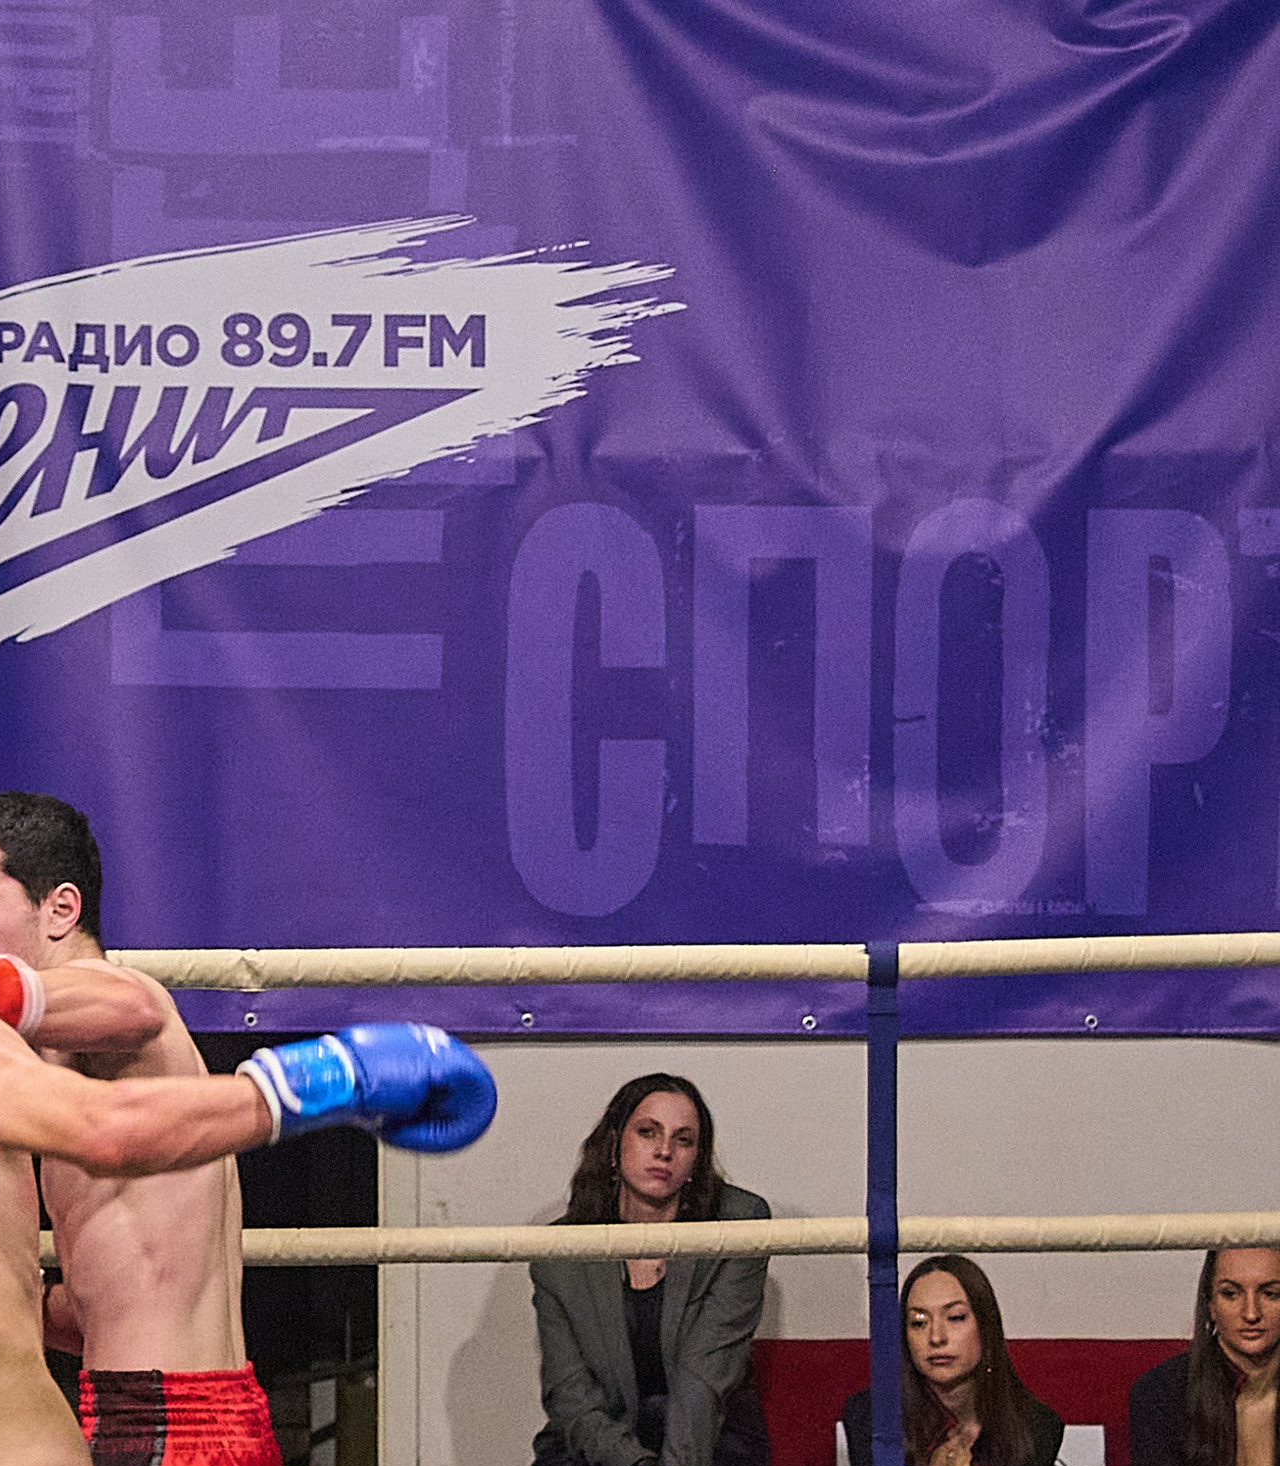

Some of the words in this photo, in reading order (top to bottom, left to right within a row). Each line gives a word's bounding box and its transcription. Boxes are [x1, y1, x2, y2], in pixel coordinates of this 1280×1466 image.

[221, 312, 374, 368] 89.7
[383, 314, 488, 370] FM
[505, 498, 1280, 918] СПОР
